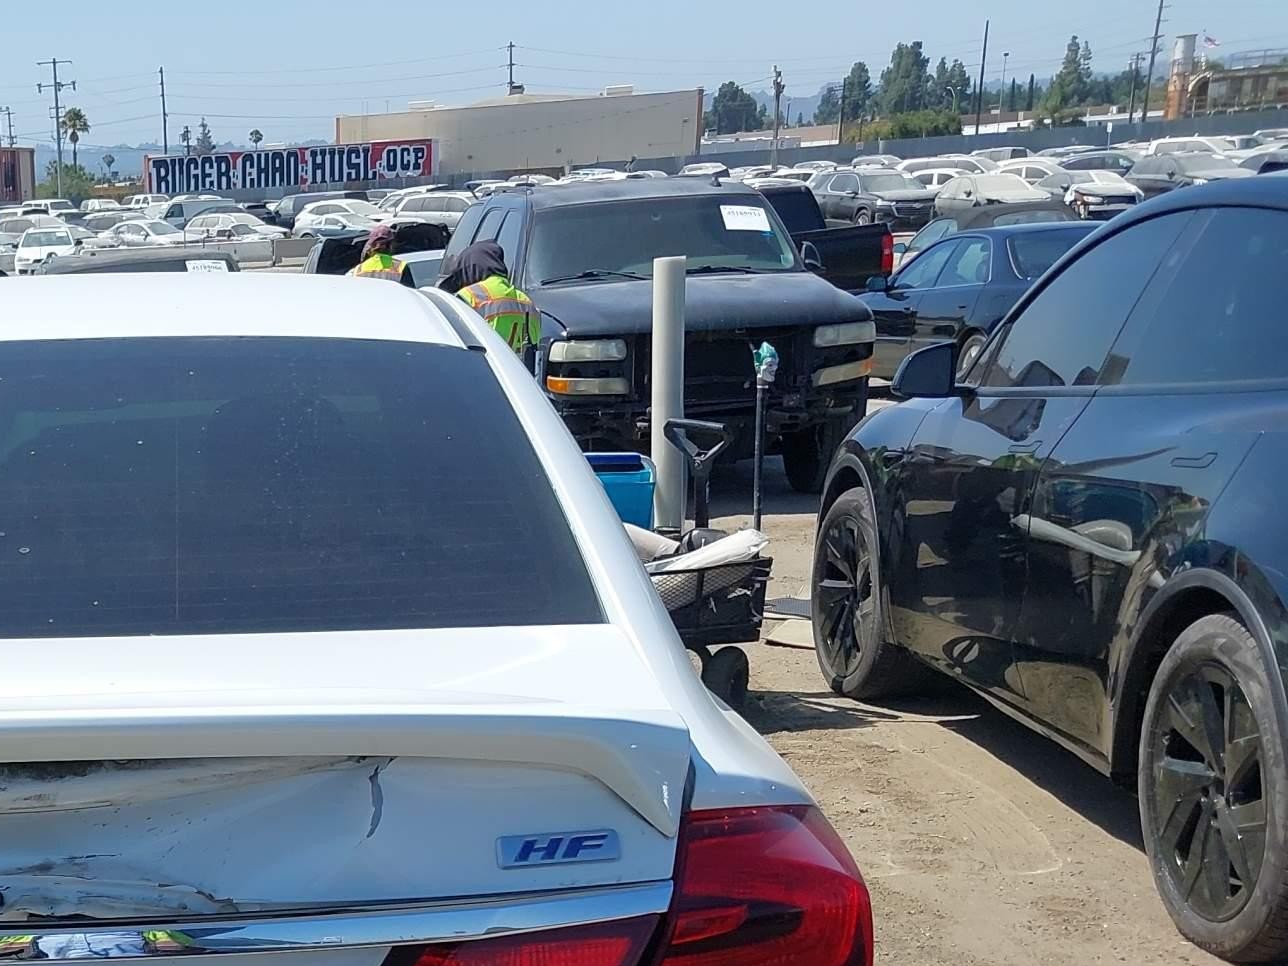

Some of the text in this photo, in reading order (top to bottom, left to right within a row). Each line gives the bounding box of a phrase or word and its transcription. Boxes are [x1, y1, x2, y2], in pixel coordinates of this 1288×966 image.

[152, 155, 232, 194] RUGER
[309, 145, 377, 185] HUSL
[513, 834, 609, 862] HF
